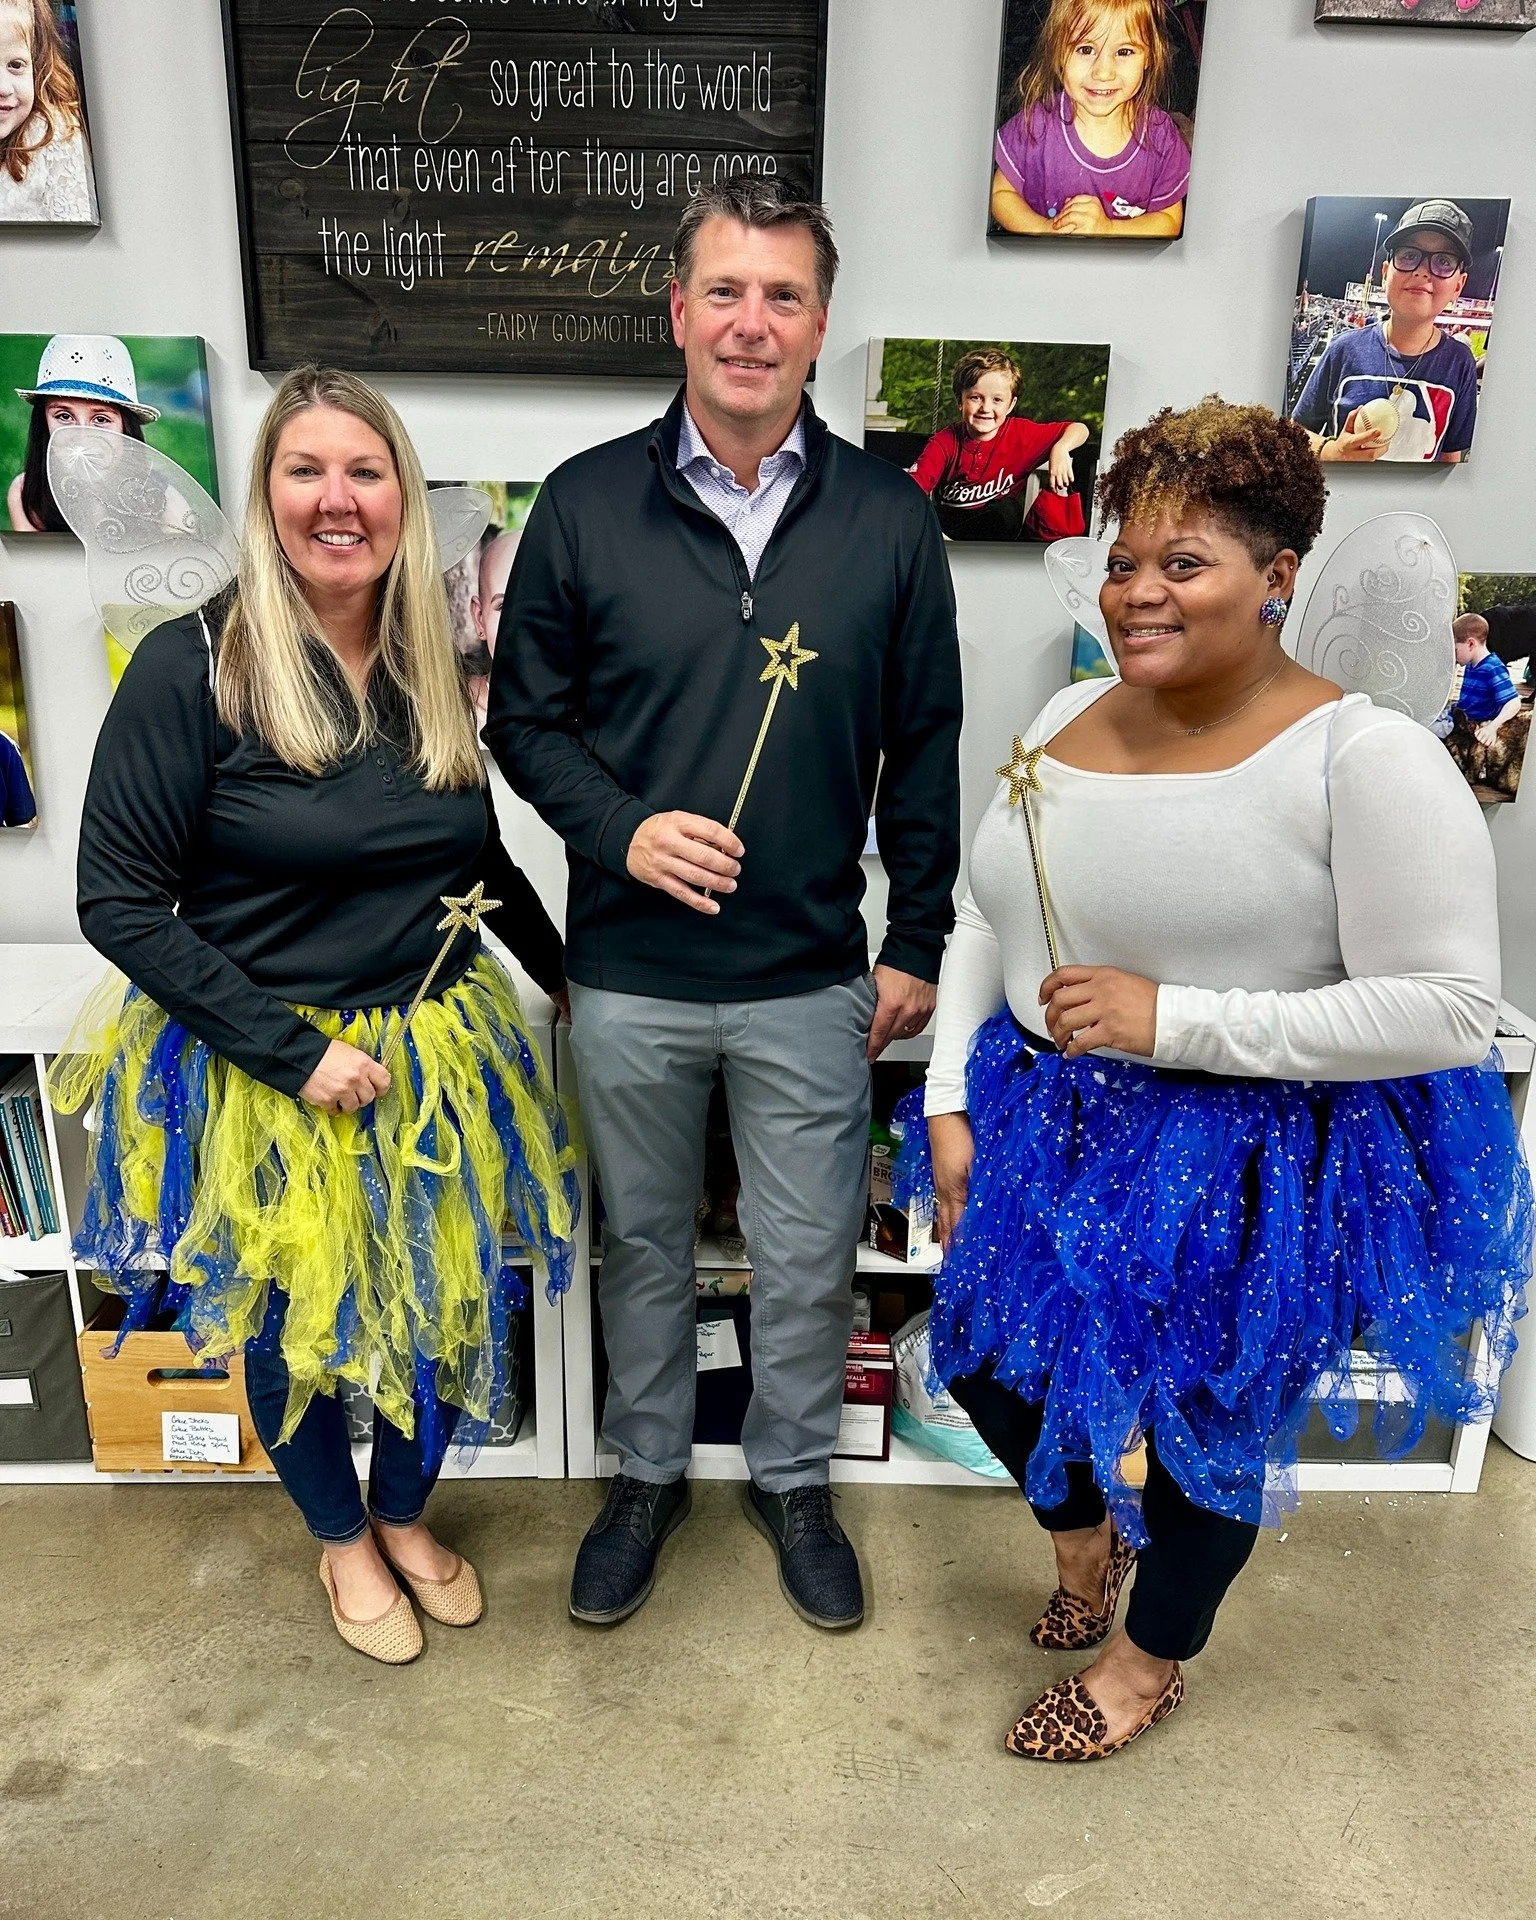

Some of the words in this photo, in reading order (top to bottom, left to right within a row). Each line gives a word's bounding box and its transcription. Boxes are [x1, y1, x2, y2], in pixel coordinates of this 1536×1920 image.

[284, 8, 470, 169] light
[490, 60, 518, 106] so
[529, 47, 598, 121] great
[608, 47, 634, 108] to
[644, 48, 686, 110] the
[696, 51, 772, 112] world
[344, 133, 401, 191] that
[414, 147, 481, 192] even
[492, 136, 571, 194] after
[582, 138, 645, 209] they
[656, 153, 702, 197] are
[318, 217, 371, 276] the
[382, 218, 446, 291] light
[477, 312, 540, 342] -FAIRY
[552, 313, 669, 344] GODMOTHER
